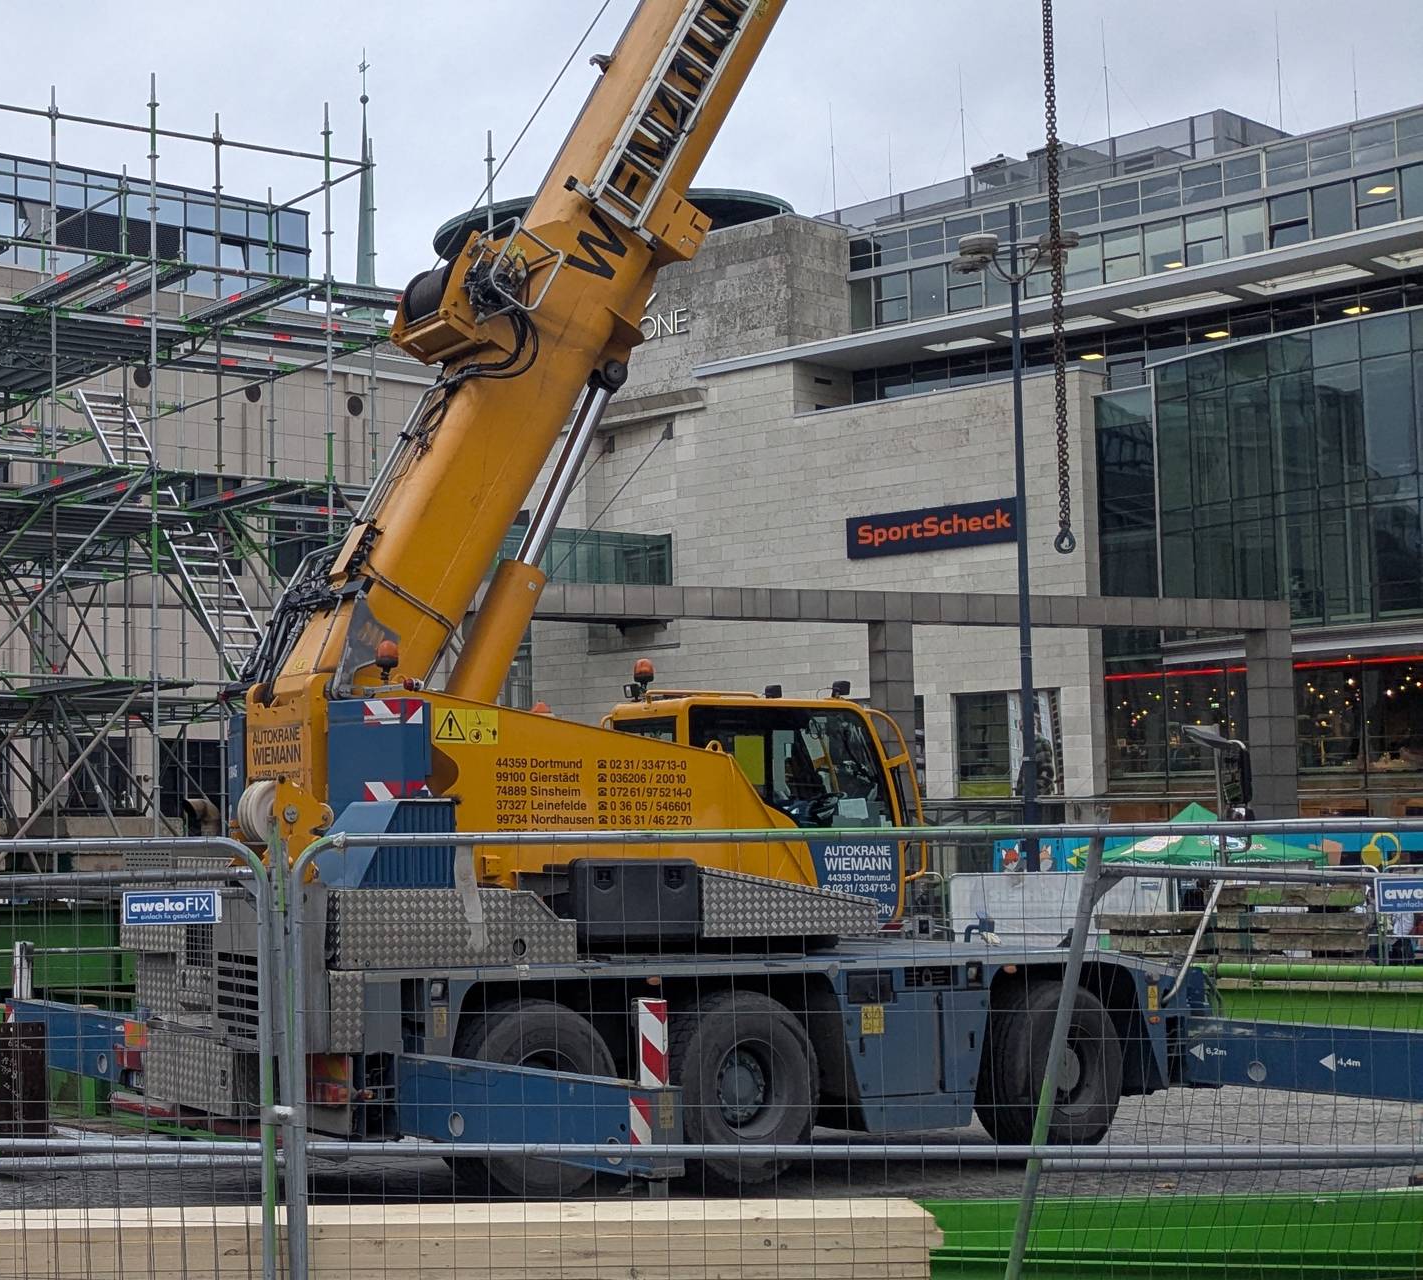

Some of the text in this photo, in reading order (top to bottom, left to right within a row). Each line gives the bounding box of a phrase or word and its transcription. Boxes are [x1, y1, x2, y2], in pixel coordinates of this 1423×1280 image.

[565, 0, 741, 281] WEMANN
[857, 508, 1011, 546] SportScheck
[252, 726, 300, 746] AUTOKRANE
[252, 744, 301, 766] WIEMANN
[496, 758, 527, 769] 44359
[530, 758, 582, 769] Dortmund
[496, 772, 525, 783] 99100
[529, 772, 579, 783] Gierstädt
[610, 773, 646, 784] 036206
[496, 786, 527, 796] 74889
[530, 786, 581, 796] Sinsheim
[496, 800, 526, 811] 37327
[531, 800, 587, 811] Leinefelde
[656, 801, 691, 811] 546601
[496, 815, 527, 825] 99734
[531, 814, 595, 825] Nordhausen
[824, 845, 891, 856] AUTOKRANE
[824, 857, 892, 871] WIEMANN
[827, 873, 891, 882] 44359 Dortmund
[130, 896, 210, 912] awekoFIX
[877, 903, 896, 916] City
[140, 912, 163, 920] einfach
[173, 912, 201, 920] gesichert
